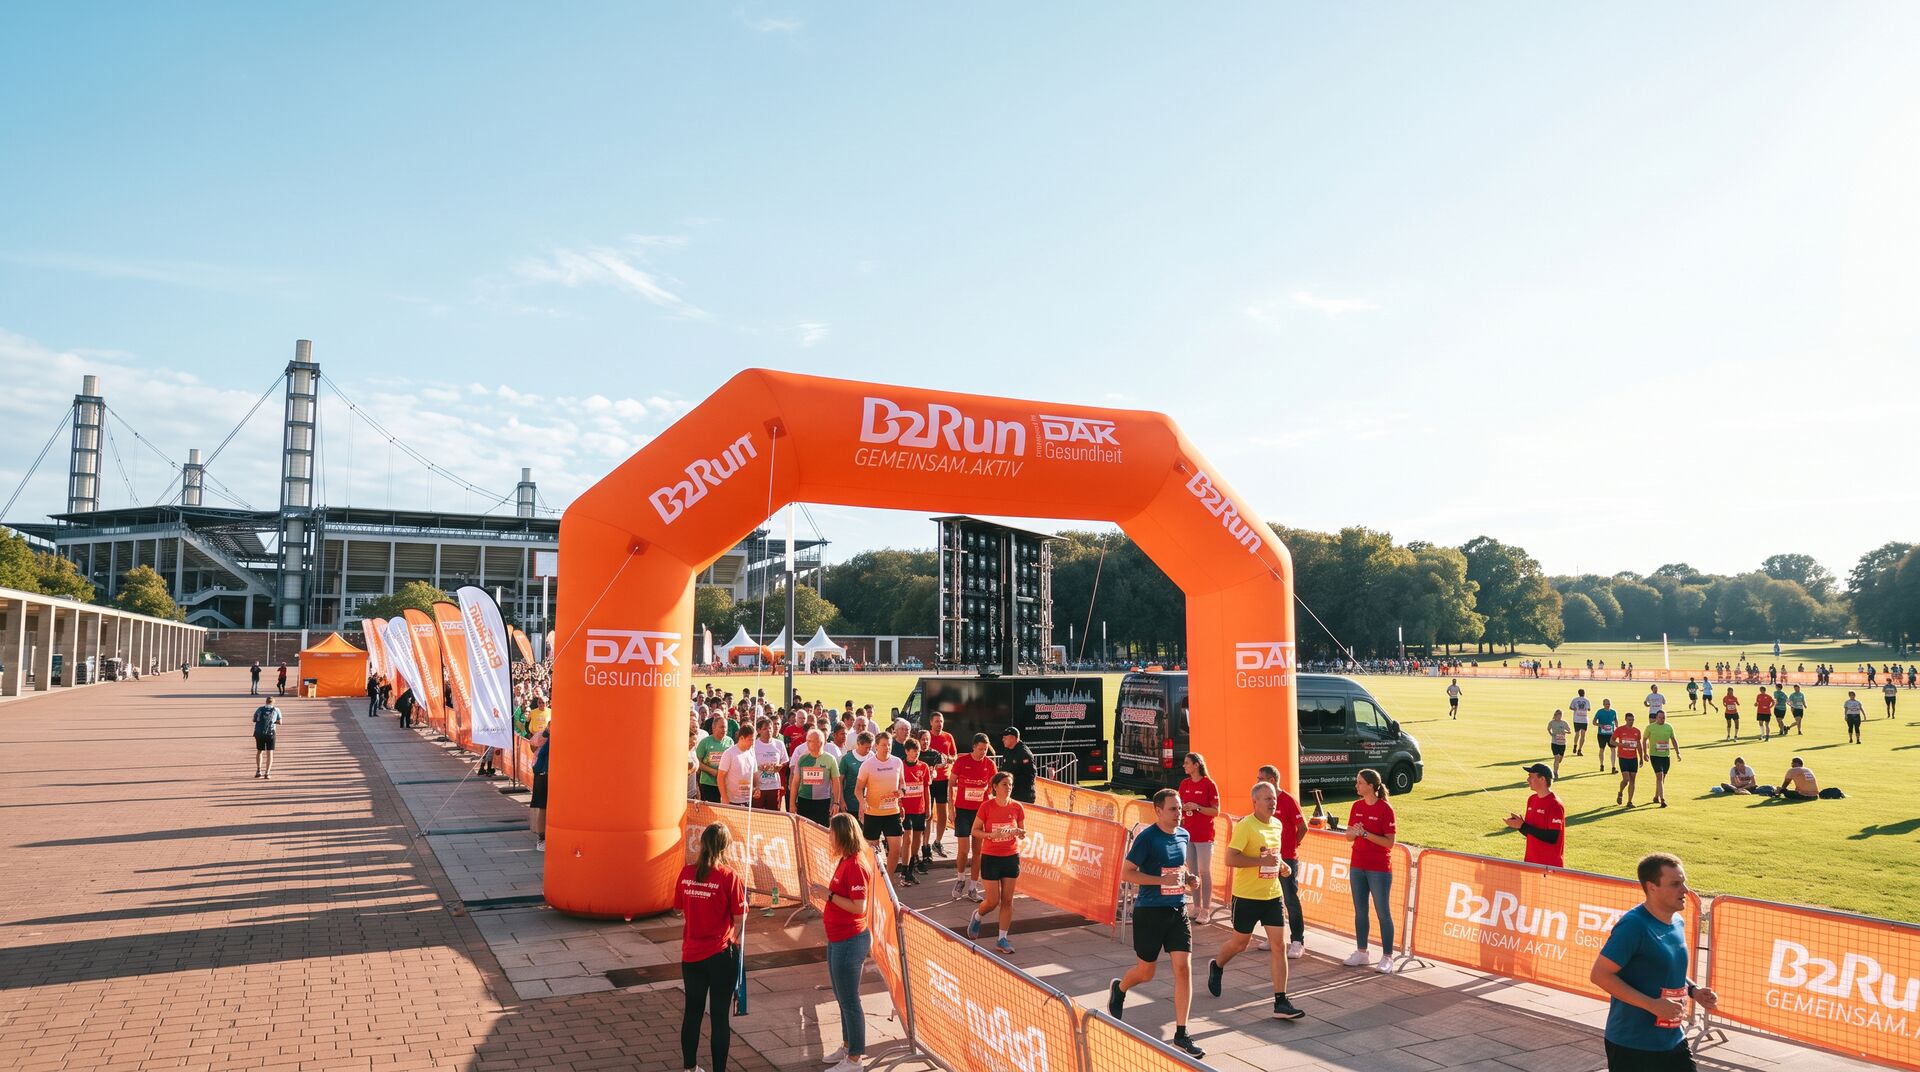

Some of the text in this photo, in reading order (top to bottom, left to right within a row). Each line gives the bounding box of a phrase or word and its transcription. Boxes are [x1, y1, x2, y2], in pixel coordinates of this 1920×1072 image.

[859, 396, 1026, 457] B2Run
[1039, 414, 1121, 446] DAK
[1045, 441, 1122, 463] Gesundheit
[648, 432, 758, 525] B2Run
[1185, 469, 1262, 554] B2Run
[586, 629, 681, 667] DAK
[585, 665, 681, 687] Gesundheit
[1236, 671, 1296, 688] Gesundh
[1017, 831, 1066, 868] 2Run
[1069, 839, 1104, 867] DAK
[1445, 881, 1568, 941] B2Run
[1578, 903, 1629, 933] DA
[1443, 922, 1568, 961] GEMEINSAM.AKTIV
[1768, 938, 1920, 1013] B2Ru
[1765, 989, 1920, 1041] GEMEINSAM.
